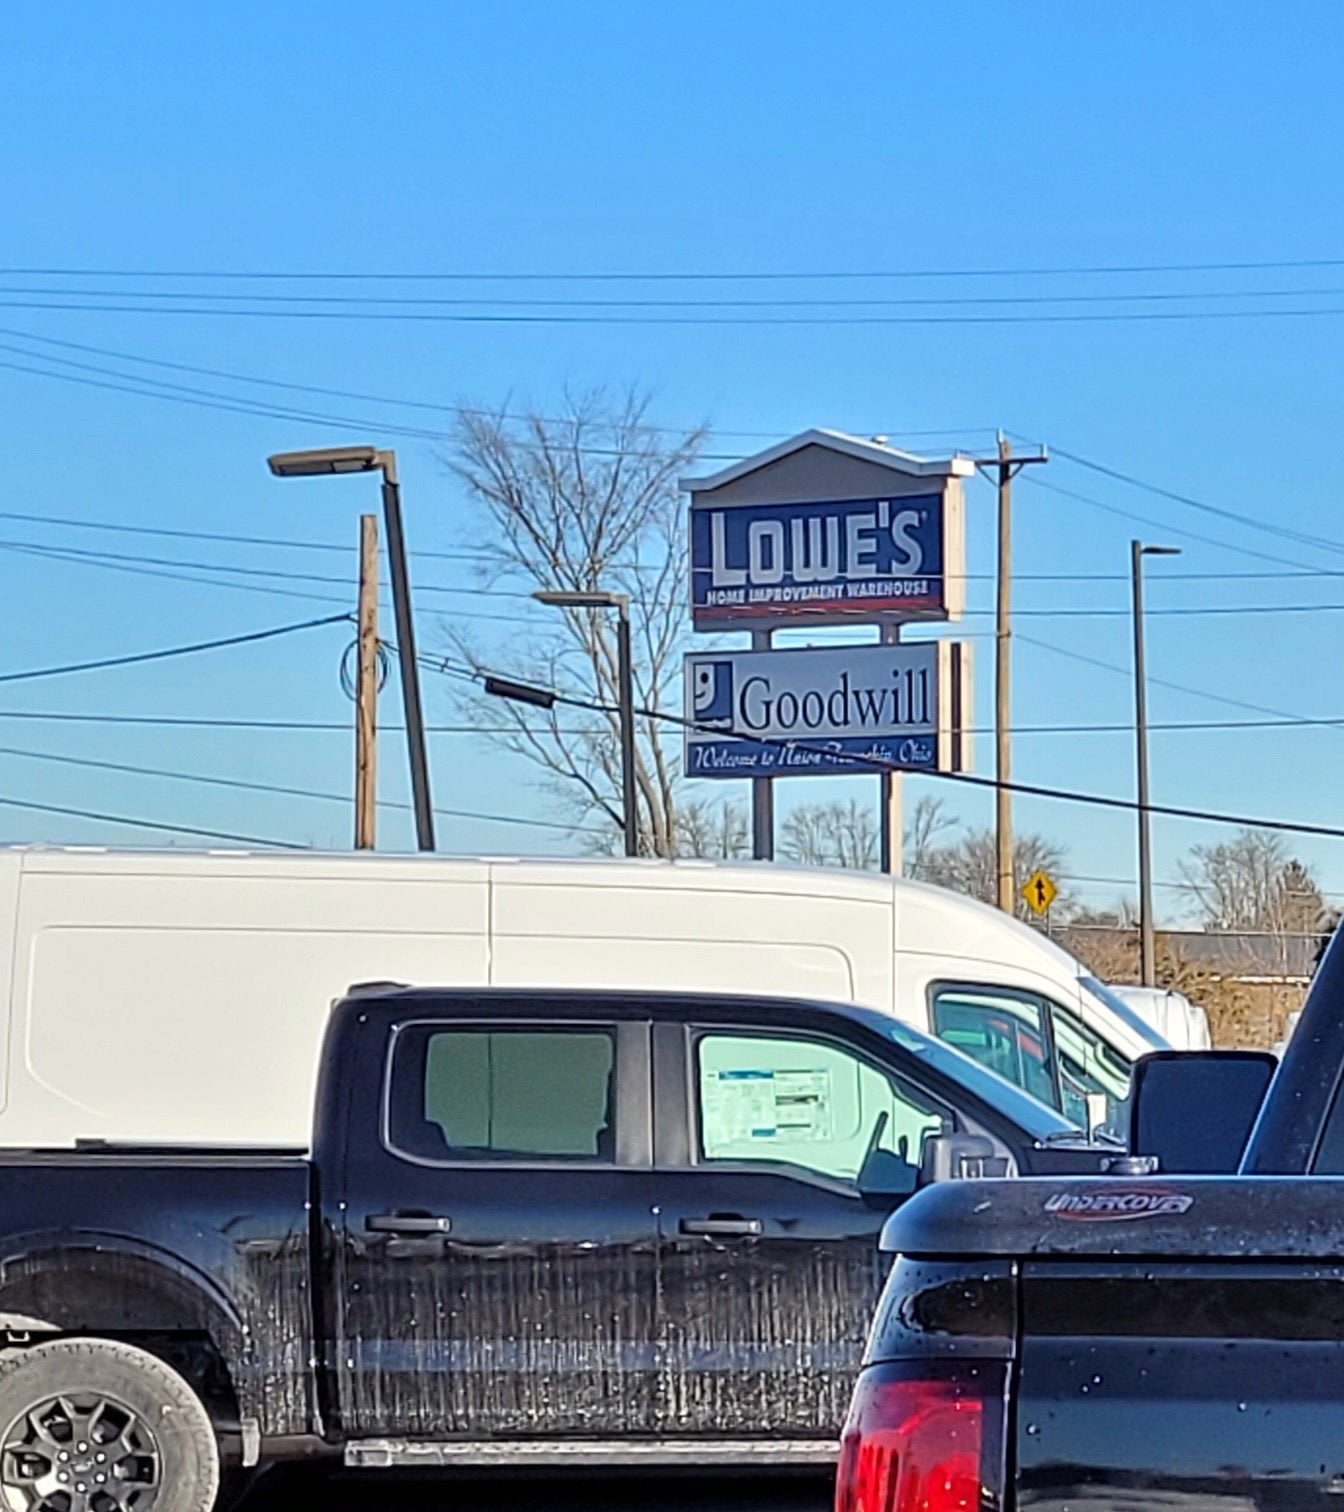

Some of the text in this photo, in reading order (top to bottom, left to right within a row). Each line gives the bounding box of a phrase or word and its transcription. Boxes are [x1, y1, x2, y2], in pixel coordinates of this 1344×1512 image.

[711, 501, 924, 587] LOWE'S
[706, 580, 929, 605] HOME IMPROVEMENT WAREHOUSE
[738, 667, 933, 731] Goodwill
